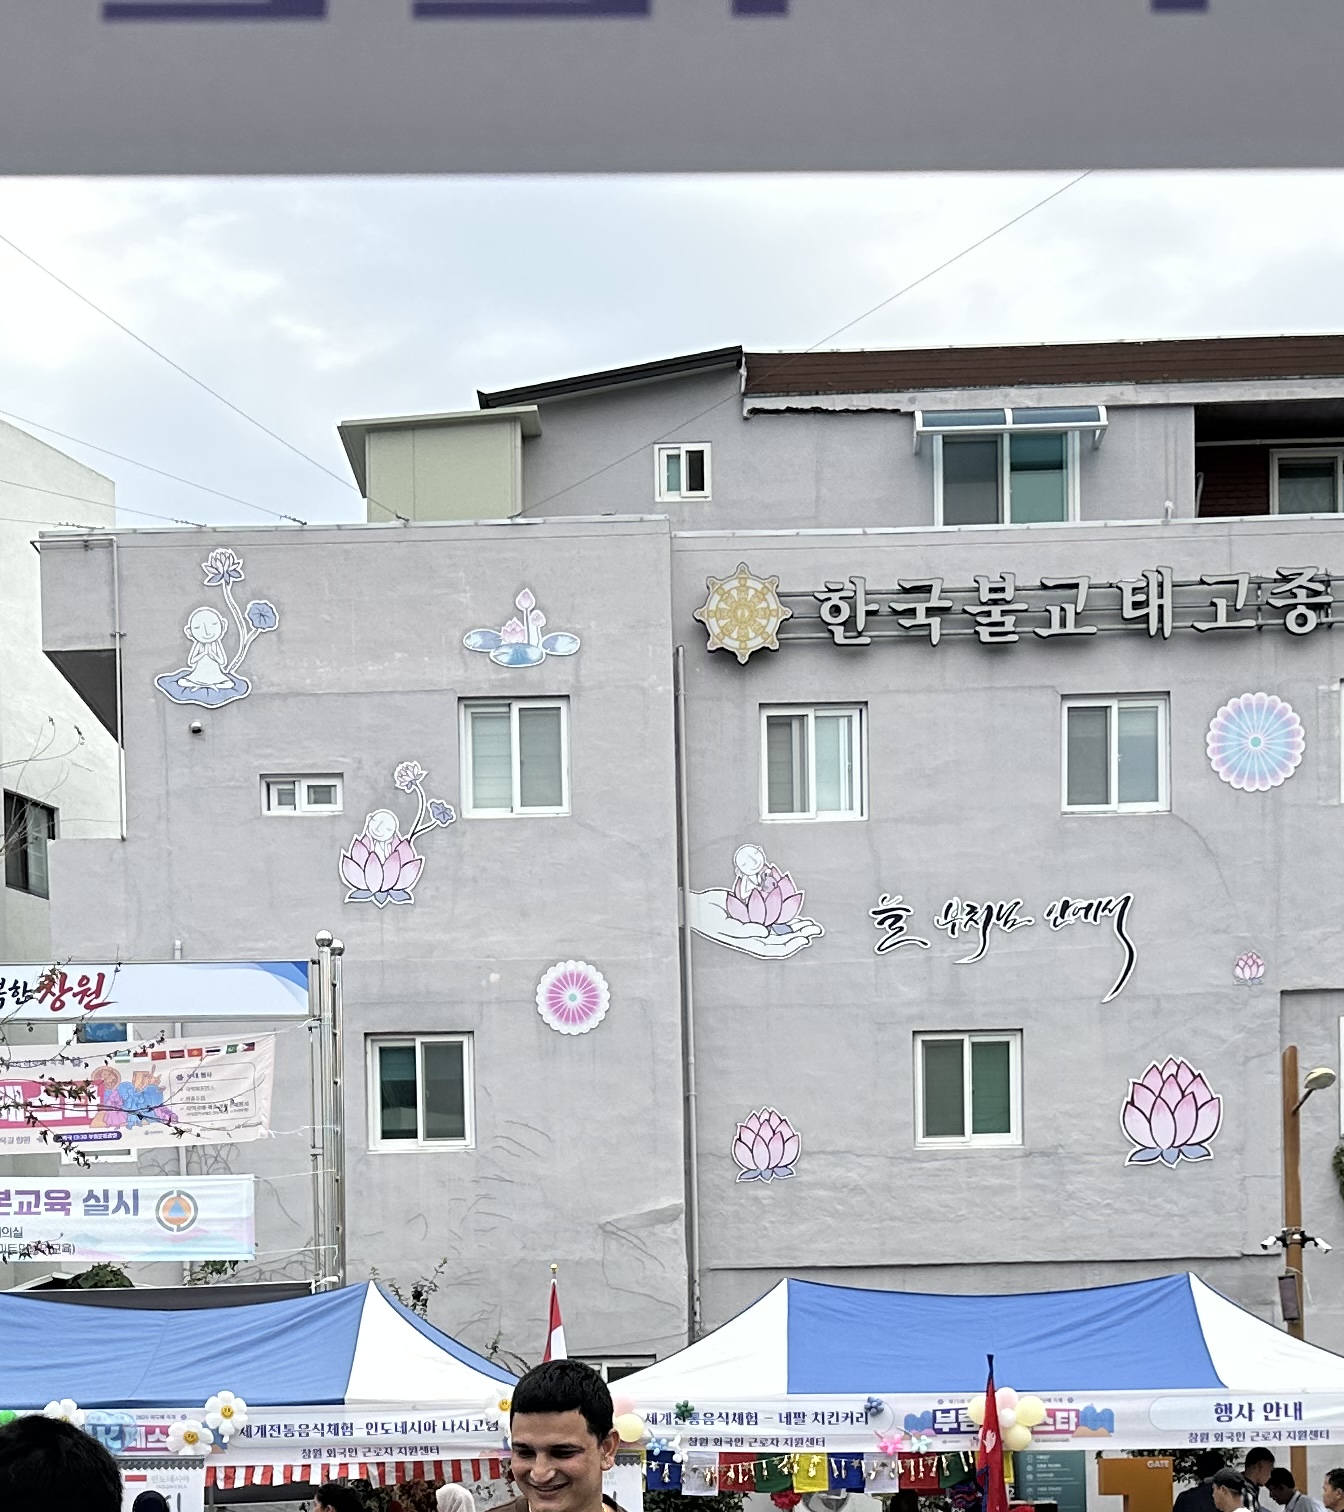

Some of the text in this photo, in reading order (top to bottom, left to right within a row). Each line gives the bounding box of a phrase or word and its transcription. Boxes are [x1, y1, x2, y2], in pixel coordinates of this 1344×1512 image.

[812, 565, 1335, 645] 한국불교태고종
[934, 896, 1035, 964] 부처님
[38, 971, 118, 1012] 창원
[82, 1189, 139, 1217] 실시
[644, 1411, 870, 1426] 세계전통음식체험 네팔 치킨커리
[1214, 1401, 1303, 1423] 행사 안내
[688, 1436, 826, 1448] 창원 외국인 근로자 지원센터
[1188, 1429, 1330, 1443] 창원 외국인 근로자 지원센터
[301, 1445, 440, 1460] 창원 외국인 근로자 지원센터
